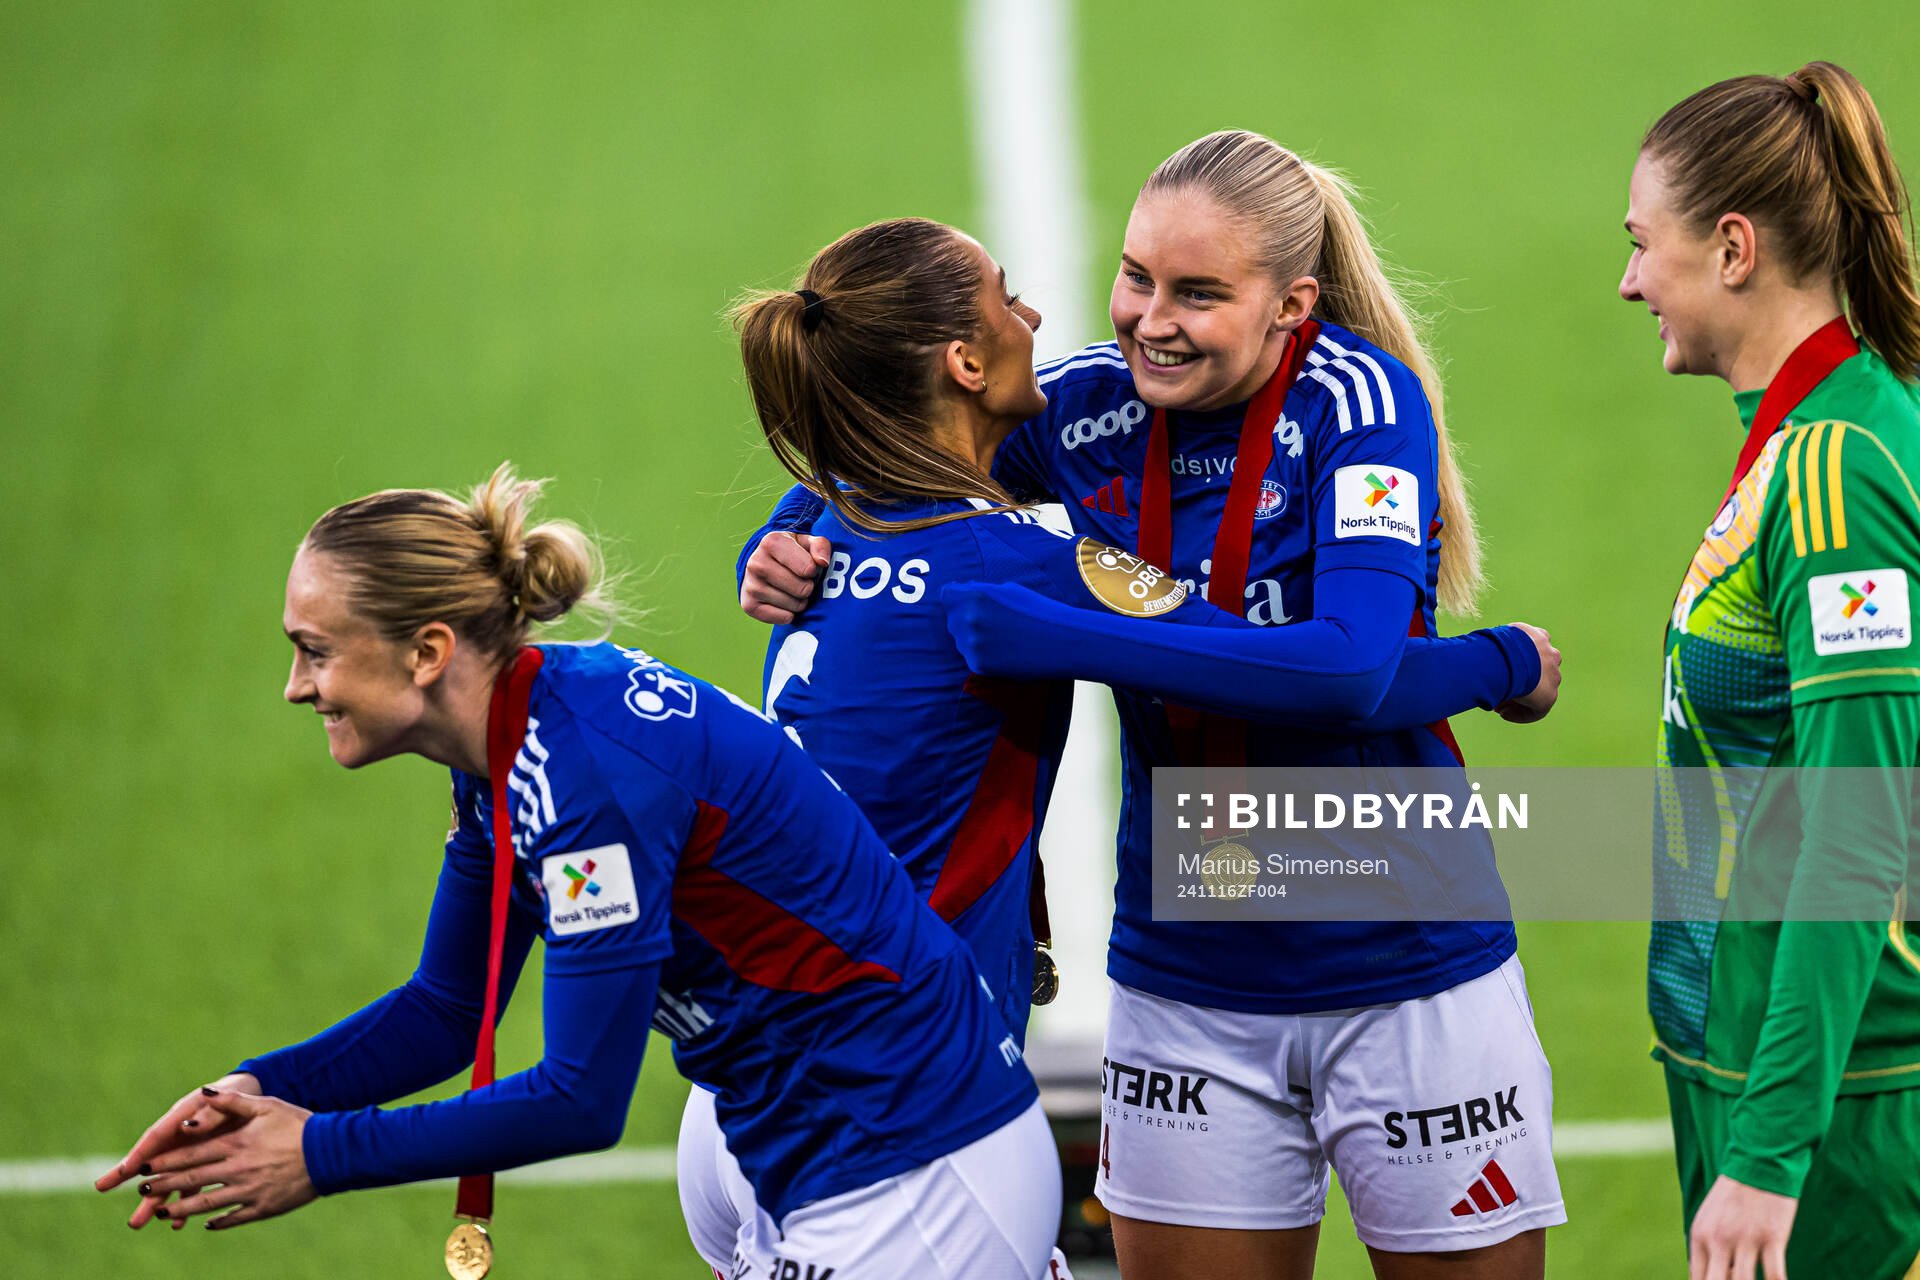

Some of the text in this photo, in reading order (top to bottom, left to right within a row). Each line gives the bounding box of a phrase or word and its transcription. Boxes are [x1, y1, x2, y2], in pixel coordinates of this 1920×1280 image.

[1061, 400, 1146, 450] coop
[1340, 515, 1416, 539] Norsk Tipping
[822, 551, 930, 604] BOS
[1128, 564, 1167, 599] OBO
[1820, 624, 1904, 643] Norsk Tipping
[554, 901, 632, 924] Norsk Tipping
[1137, 1114, 1209, 1132] TRENING
[1387, 1153, 1434, 1165] HELSE
[1463, 1127, 1528, 1156] TRENING
